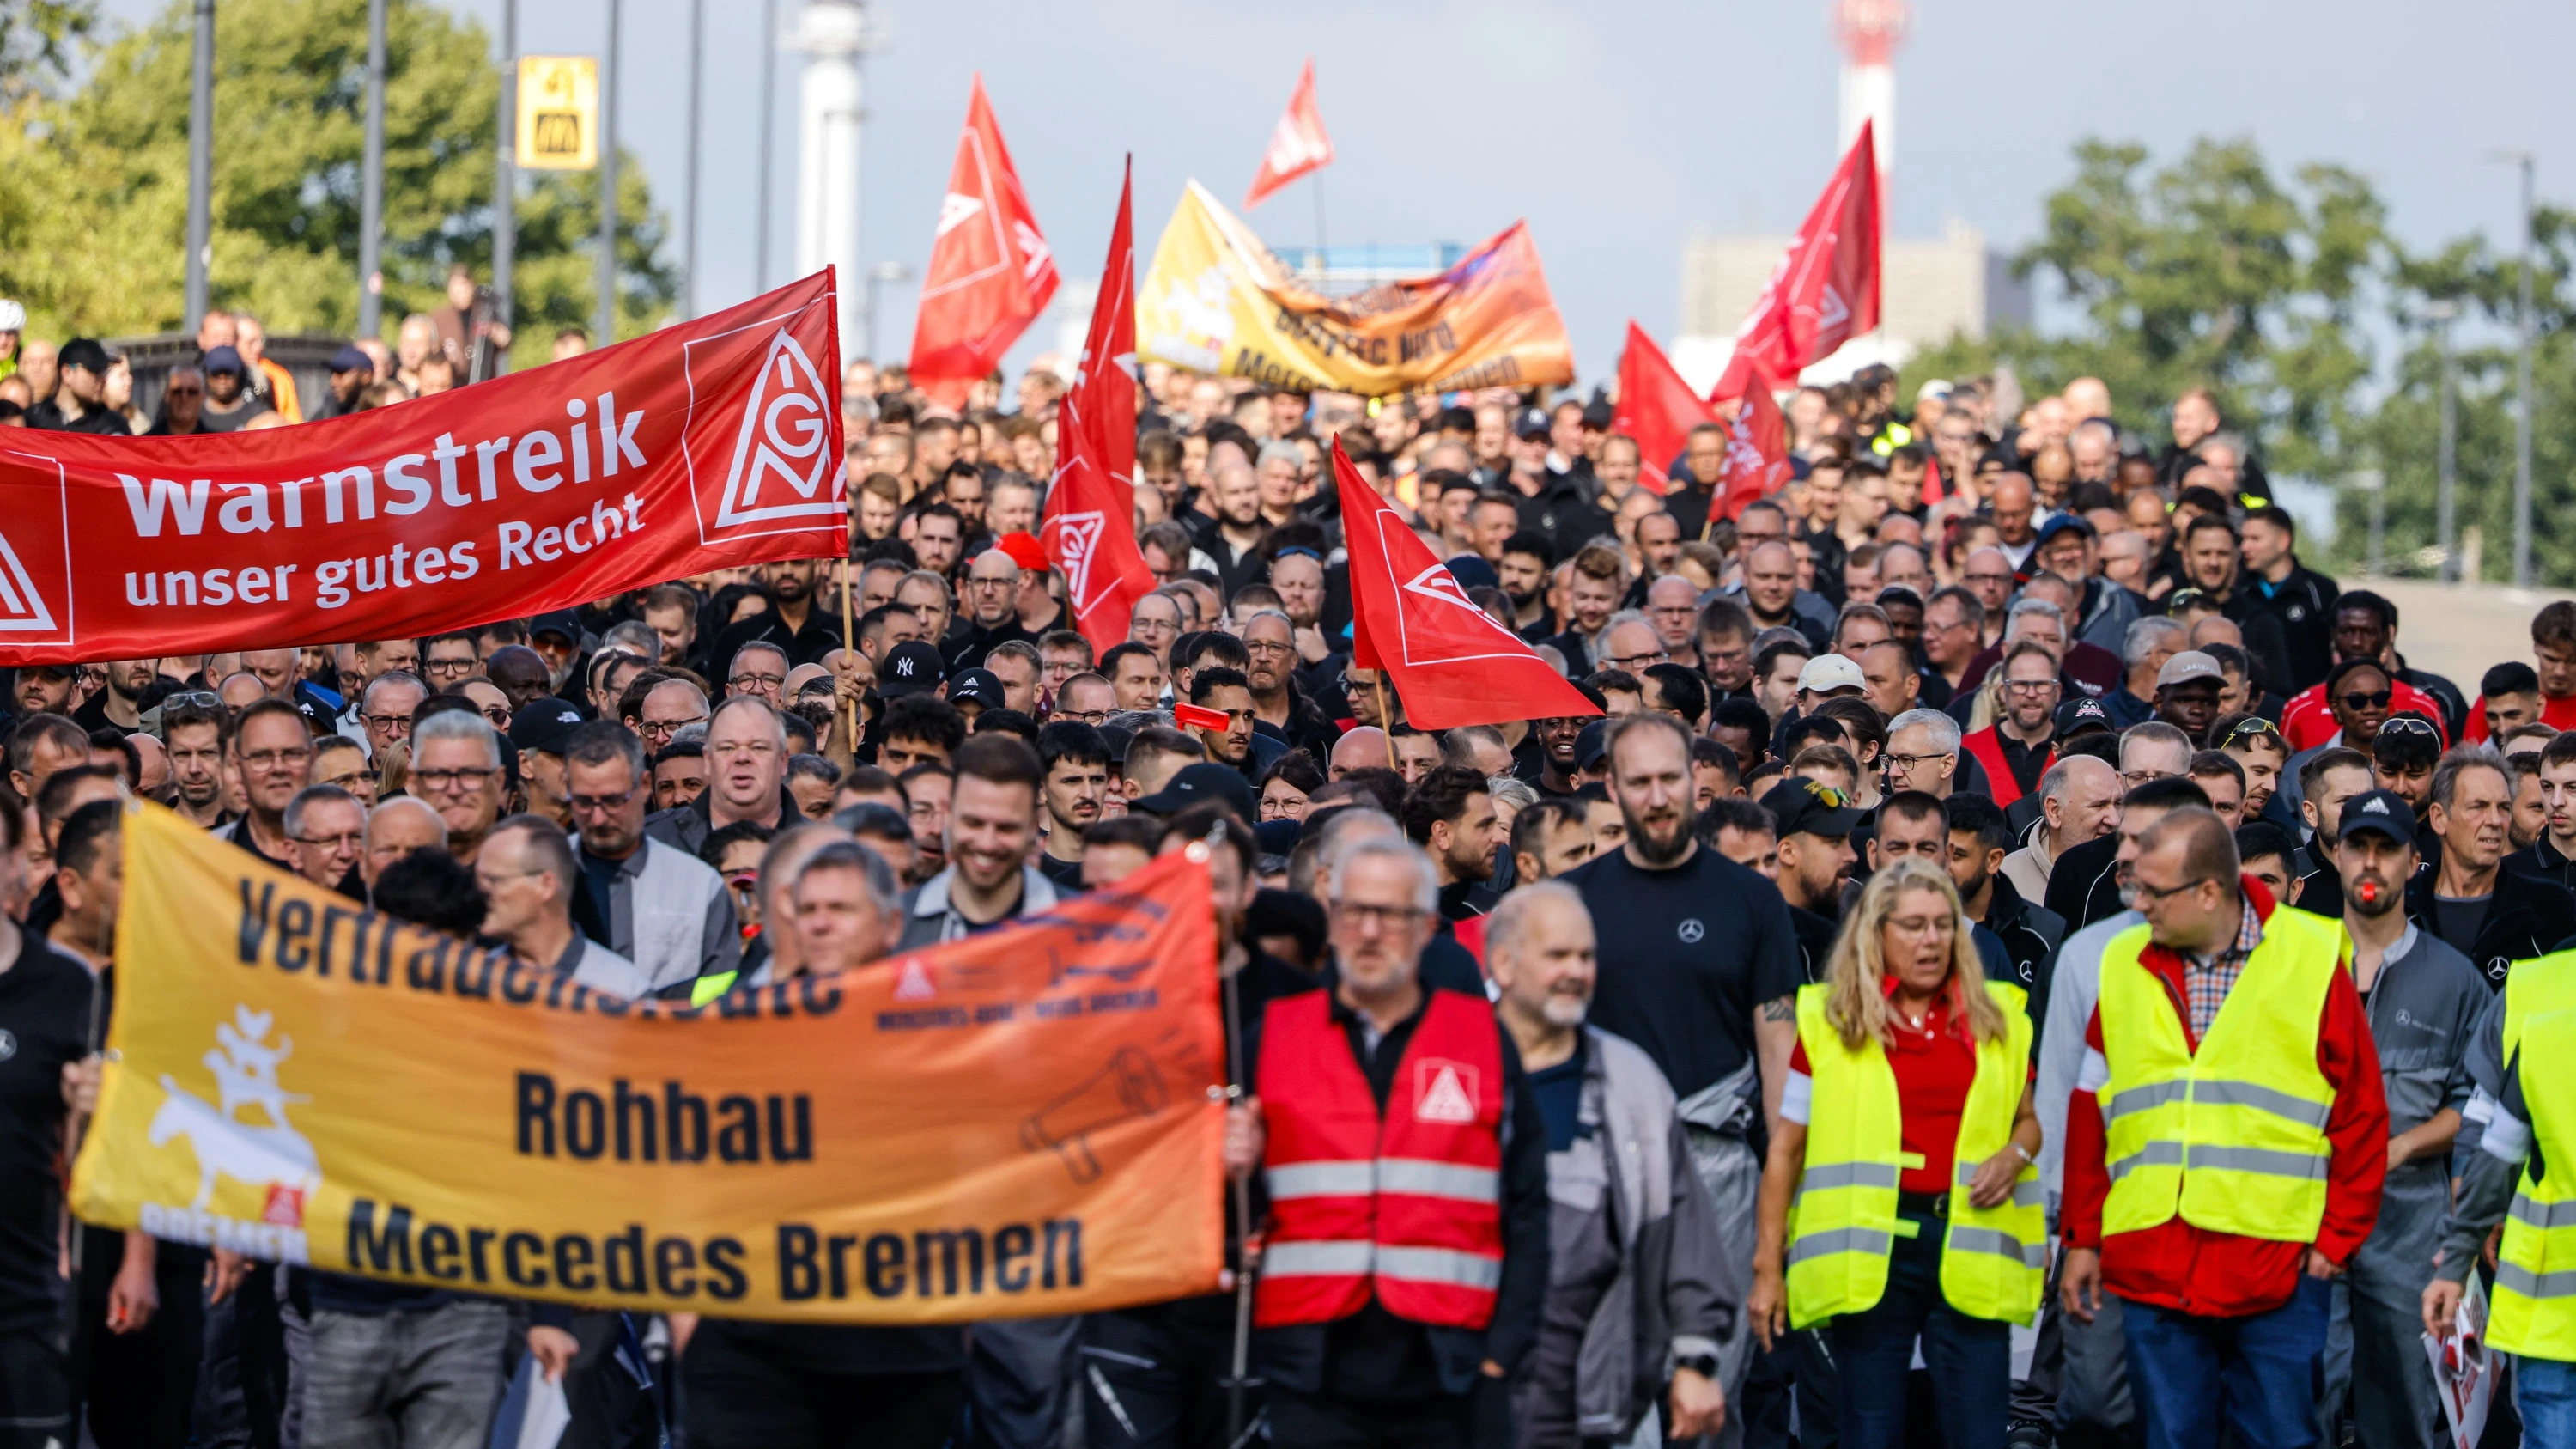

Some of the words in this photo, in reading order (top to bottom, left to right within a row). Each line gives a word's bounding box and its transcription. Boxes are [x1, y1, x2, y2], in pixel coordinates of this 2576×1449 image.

[114, 391, 649, 538] Warnstreik
[125, 563, 298, 606] unser
[314, 540, 480, 610] gutes
[498, 492, 647, 571] Recht
[896, 656, 914, 677] NY
[516, 1070, 814, 1163] Rohbau
[347, 1198, 749, 1300] Mercedes
[778, 1216, 1084, 1302] Bremen
